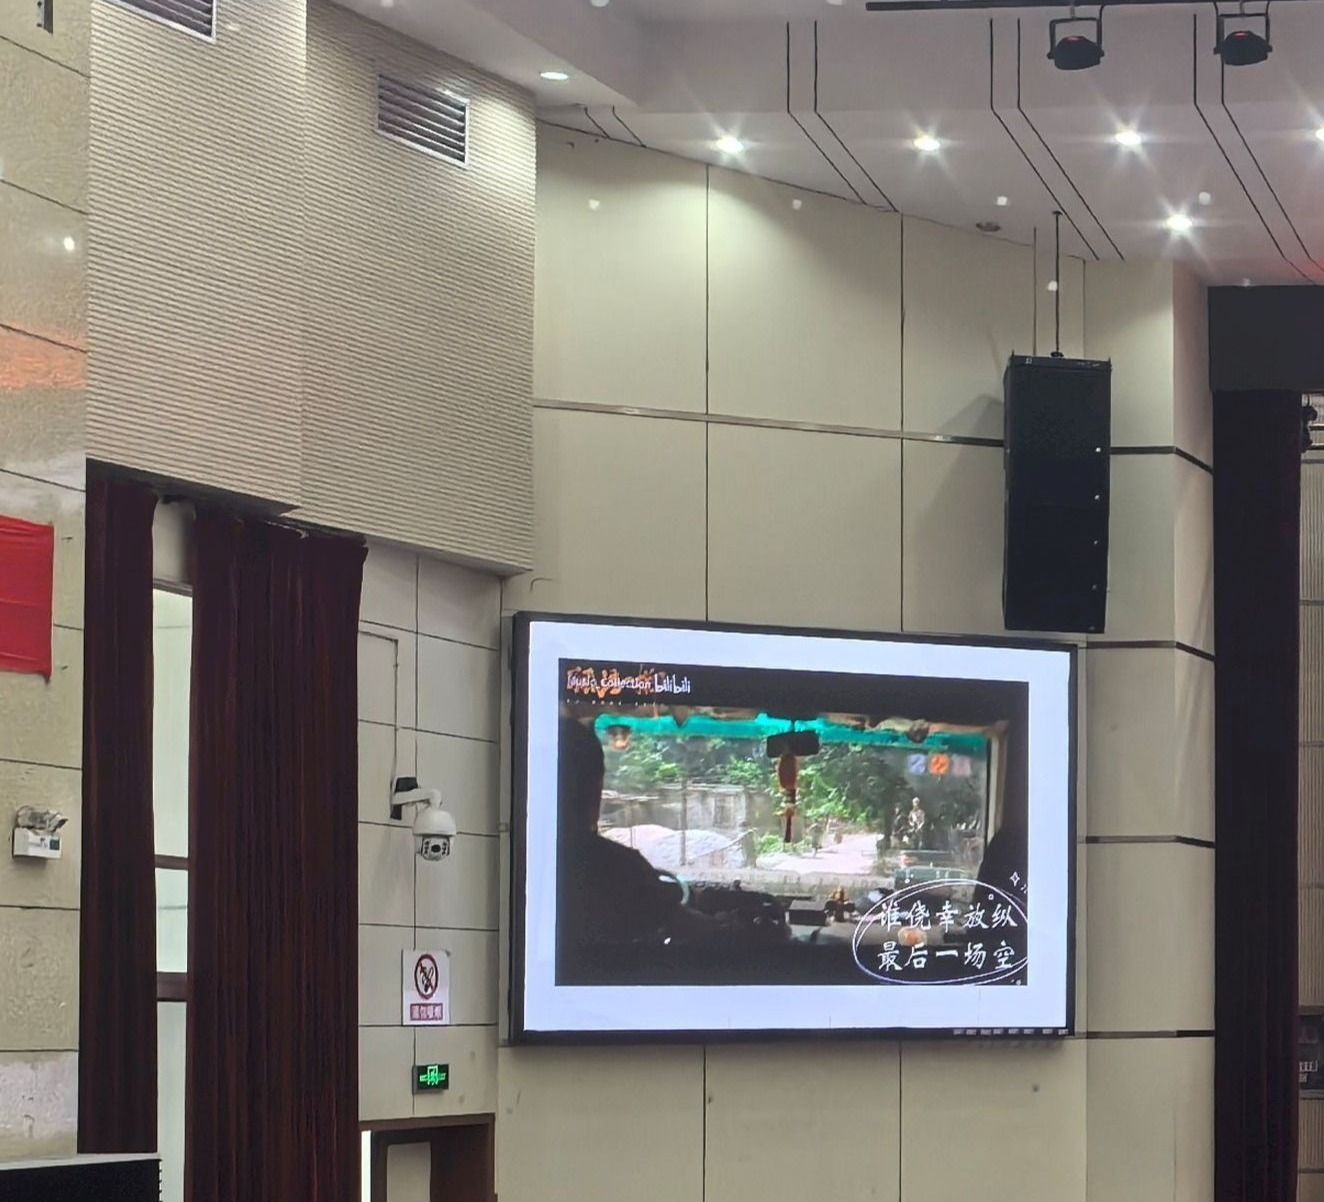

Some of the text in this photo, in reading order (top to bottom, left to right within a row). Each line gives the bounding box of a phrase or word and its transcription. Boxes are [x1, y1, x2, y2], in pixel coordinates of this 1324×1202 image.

[654, 673, 691, 694] bilibili
[876, 940, 1016, 973] 最后一场空
